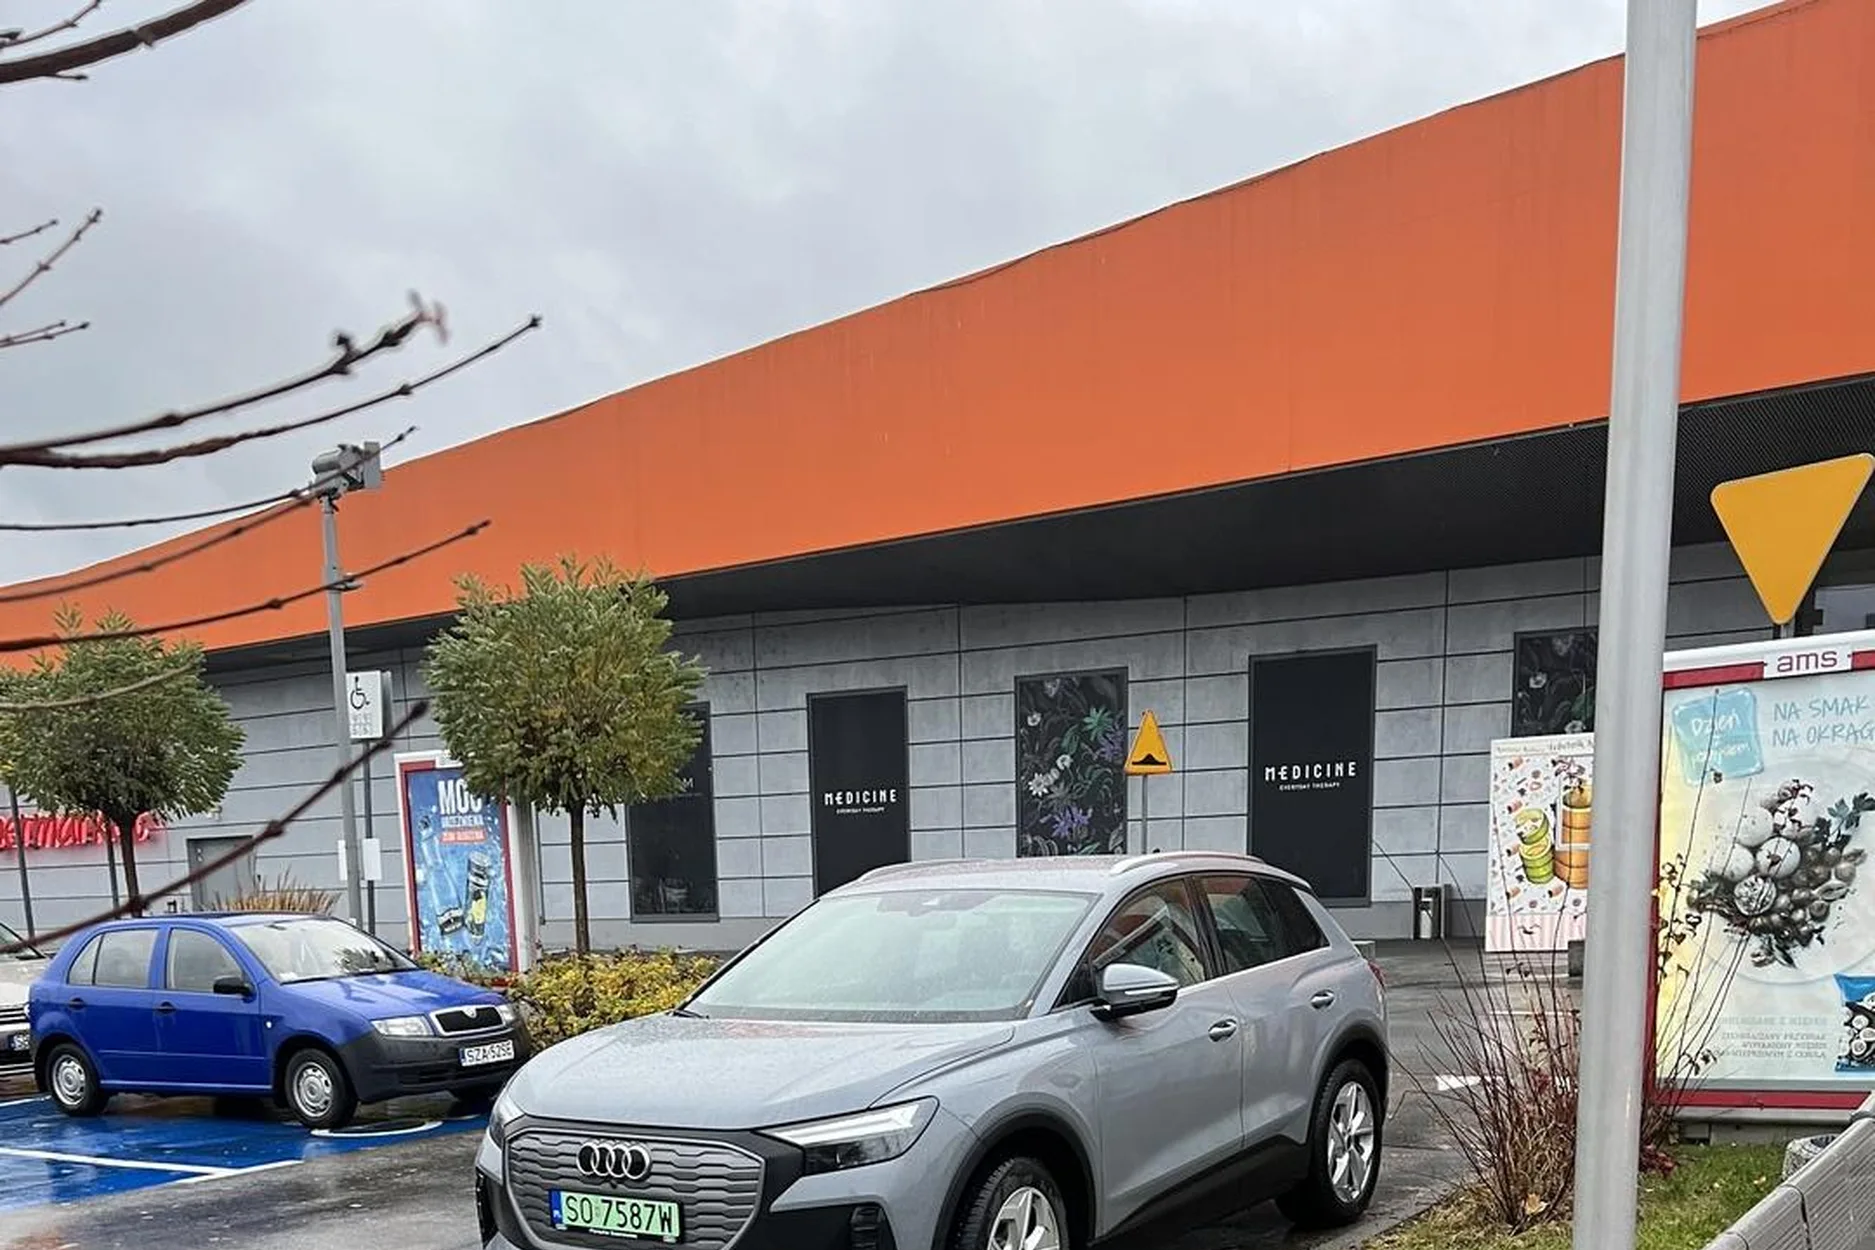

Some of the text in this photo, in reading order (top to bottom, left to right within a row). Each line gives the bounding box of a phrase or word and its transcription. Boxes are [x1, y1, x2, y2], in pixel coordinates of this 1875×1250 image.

[1777, 651, 1838, 673] ams
[1774, 695, 1870, 722] NA SMAK
[1772, 728, 1800, 747] NA
[1264, 761, 1356, 781] MEDICINE
[824, 789, 897, 806] MEDICINE
[565, 1195, 672, 1233] SO 7587W
